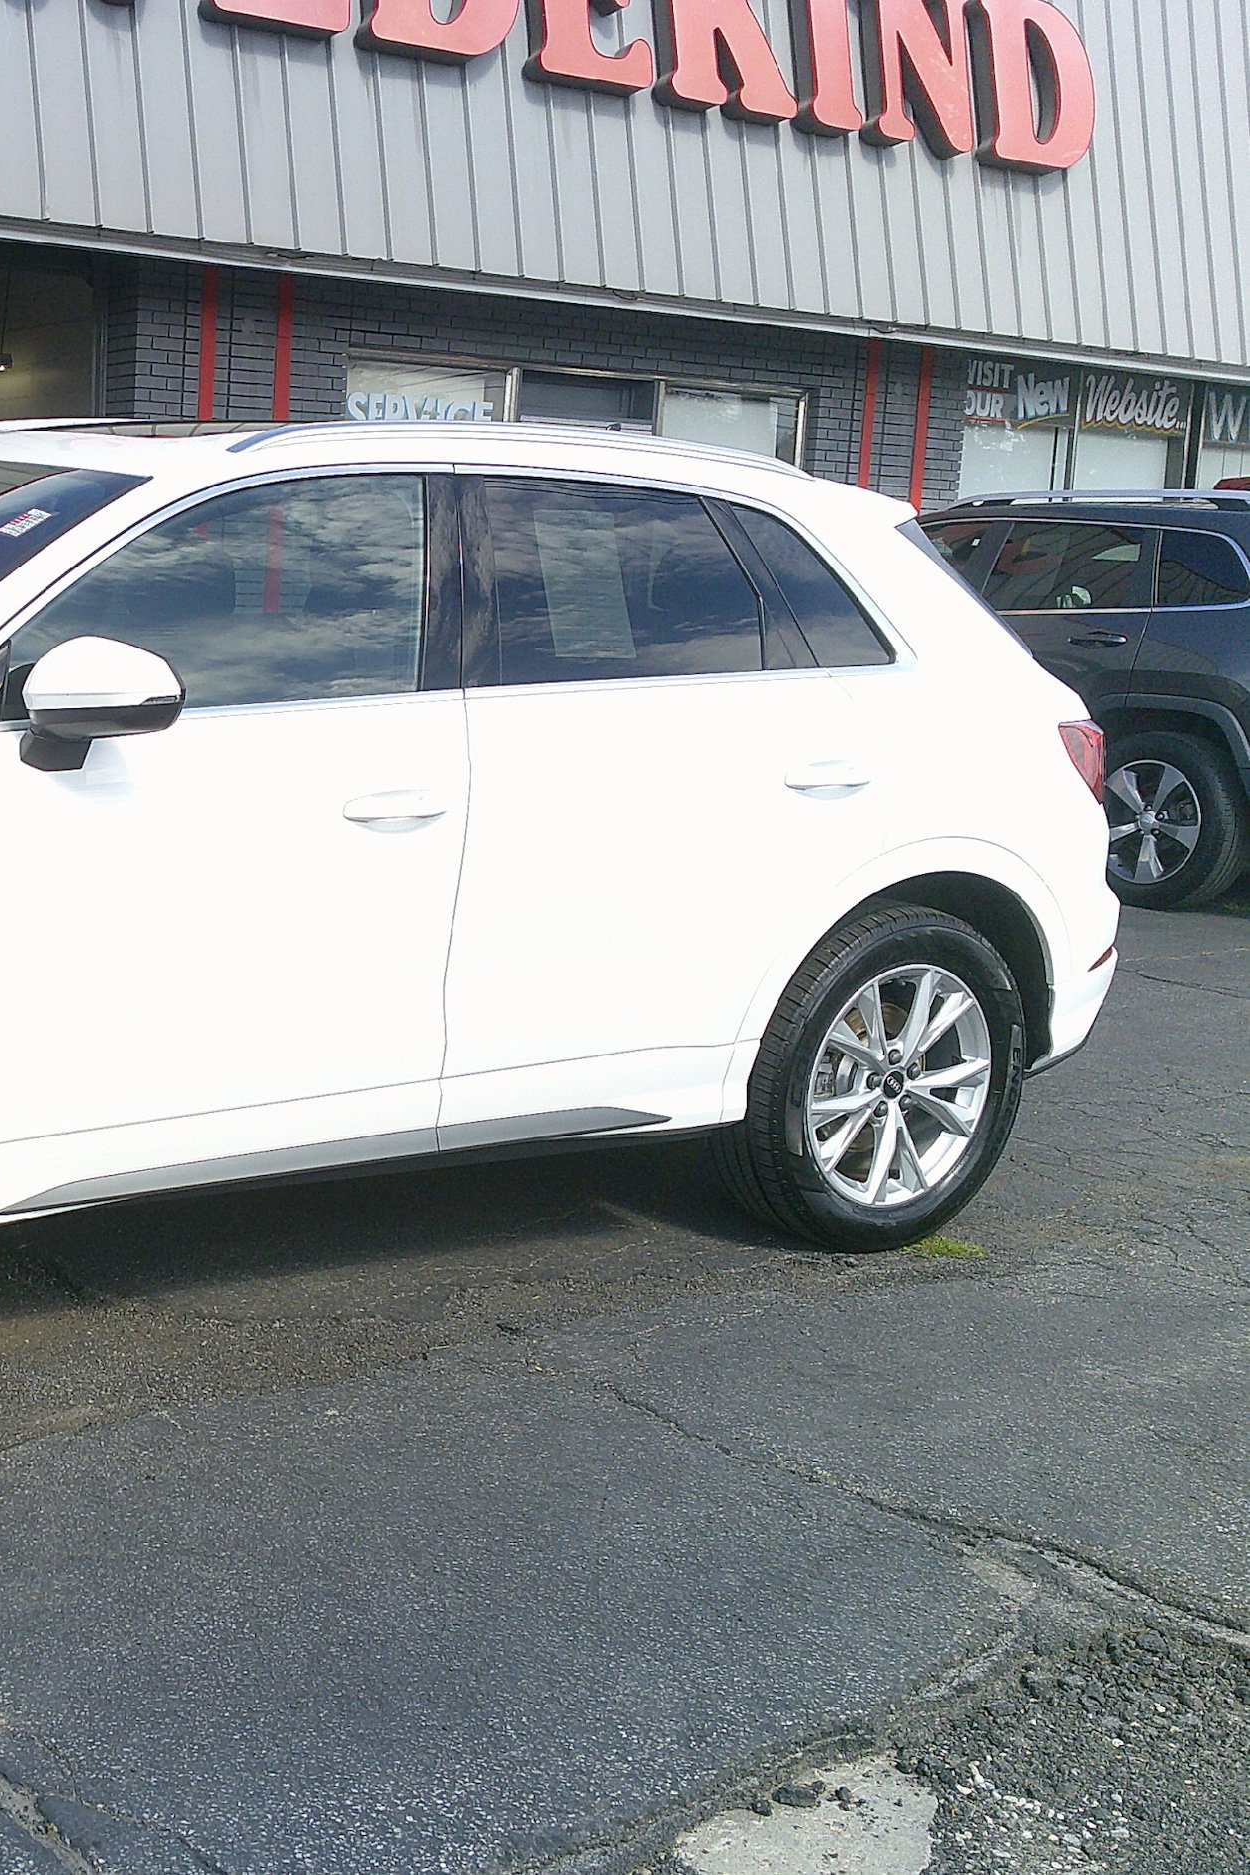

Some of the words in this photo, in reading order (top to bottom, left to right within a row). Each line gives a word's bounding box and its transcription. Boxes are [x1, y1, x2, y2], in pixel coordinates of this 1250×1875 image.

[967, 360, 1014, 389] VISIT
[963, 390, 1005, 419] OUR
[1016, 373, 1070, 421] New
